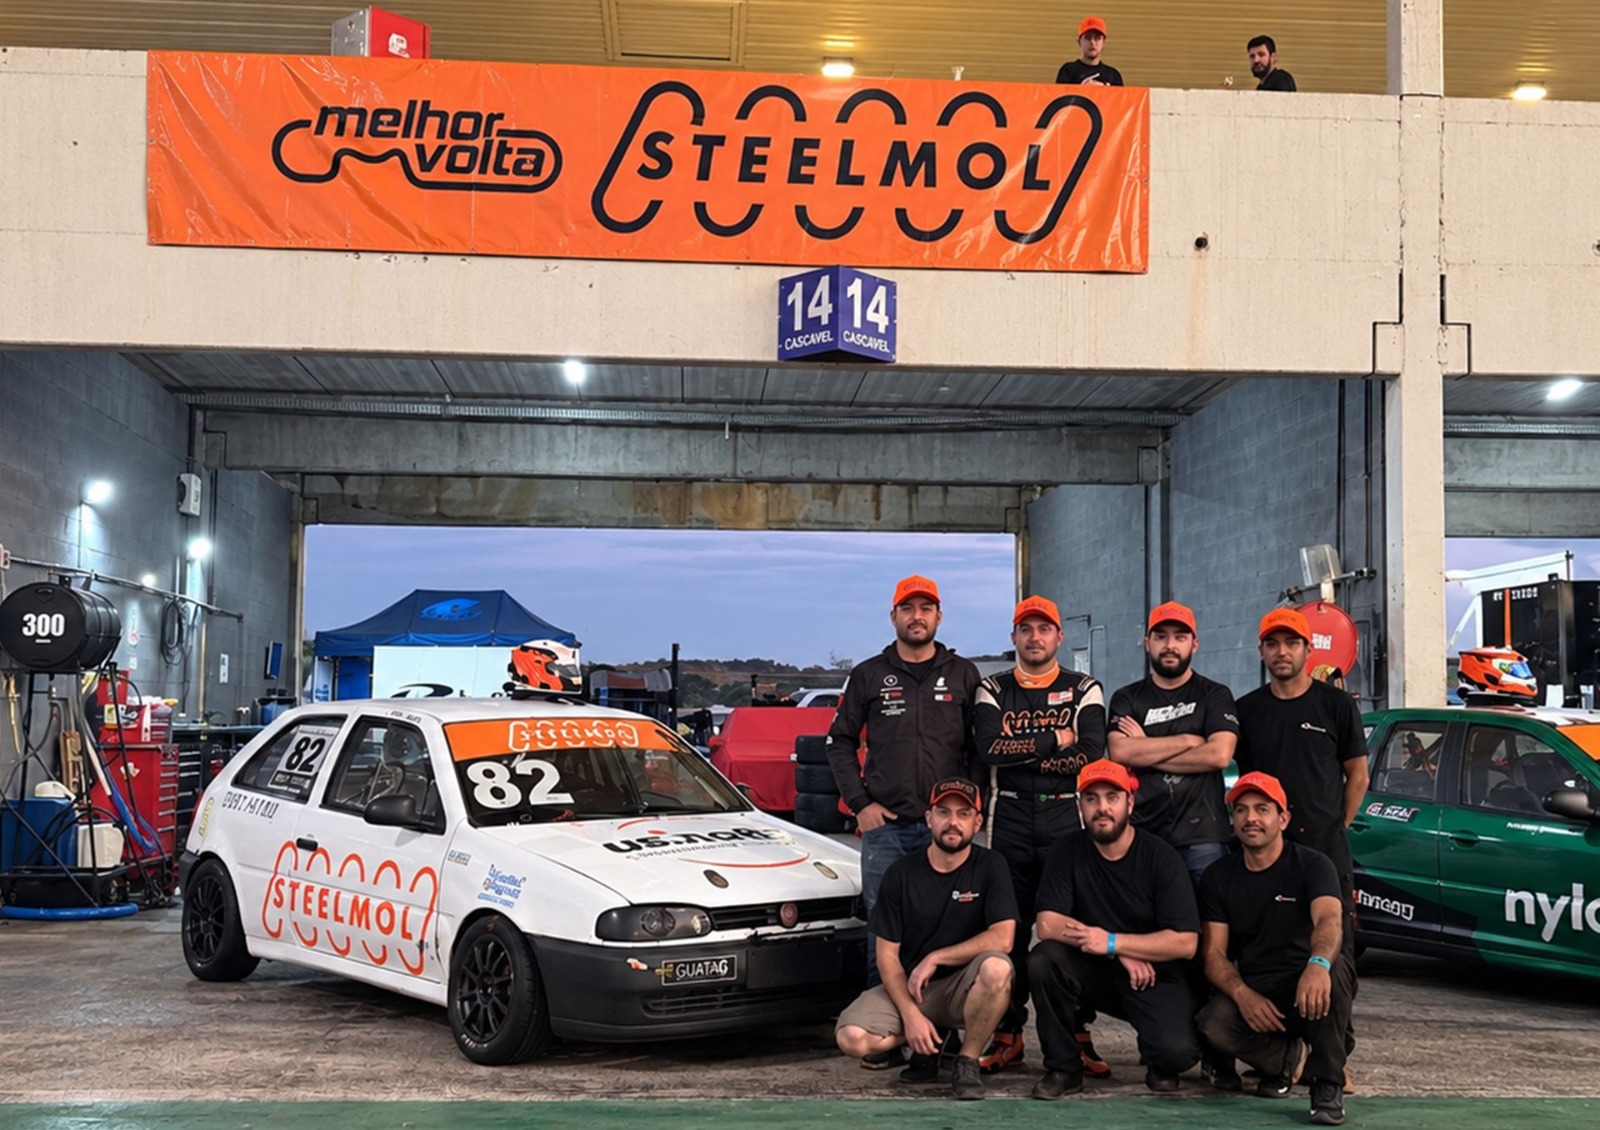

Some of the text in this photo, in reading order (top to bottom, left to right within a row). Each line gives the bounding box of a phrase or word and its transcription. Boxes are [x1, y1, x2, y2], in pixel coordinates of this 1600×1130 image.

[314, 99, 504, 140] melhor
[415, 139, 545, 177] volta
[637, 130, 1051, 191] STEELMOL
[787, 274, 833, 331] 14
[847, 277, 889, 334] 14
[784, 330, 834, 351] CASCAVEL
[843, 330, 890, 353] CASCAVEL
[22, 613, 65, 637] 300
[285, 736, 326, 772] 82
[466, 759, 575, 809] 82
[272, 877, 413, 941] STEELMOL
